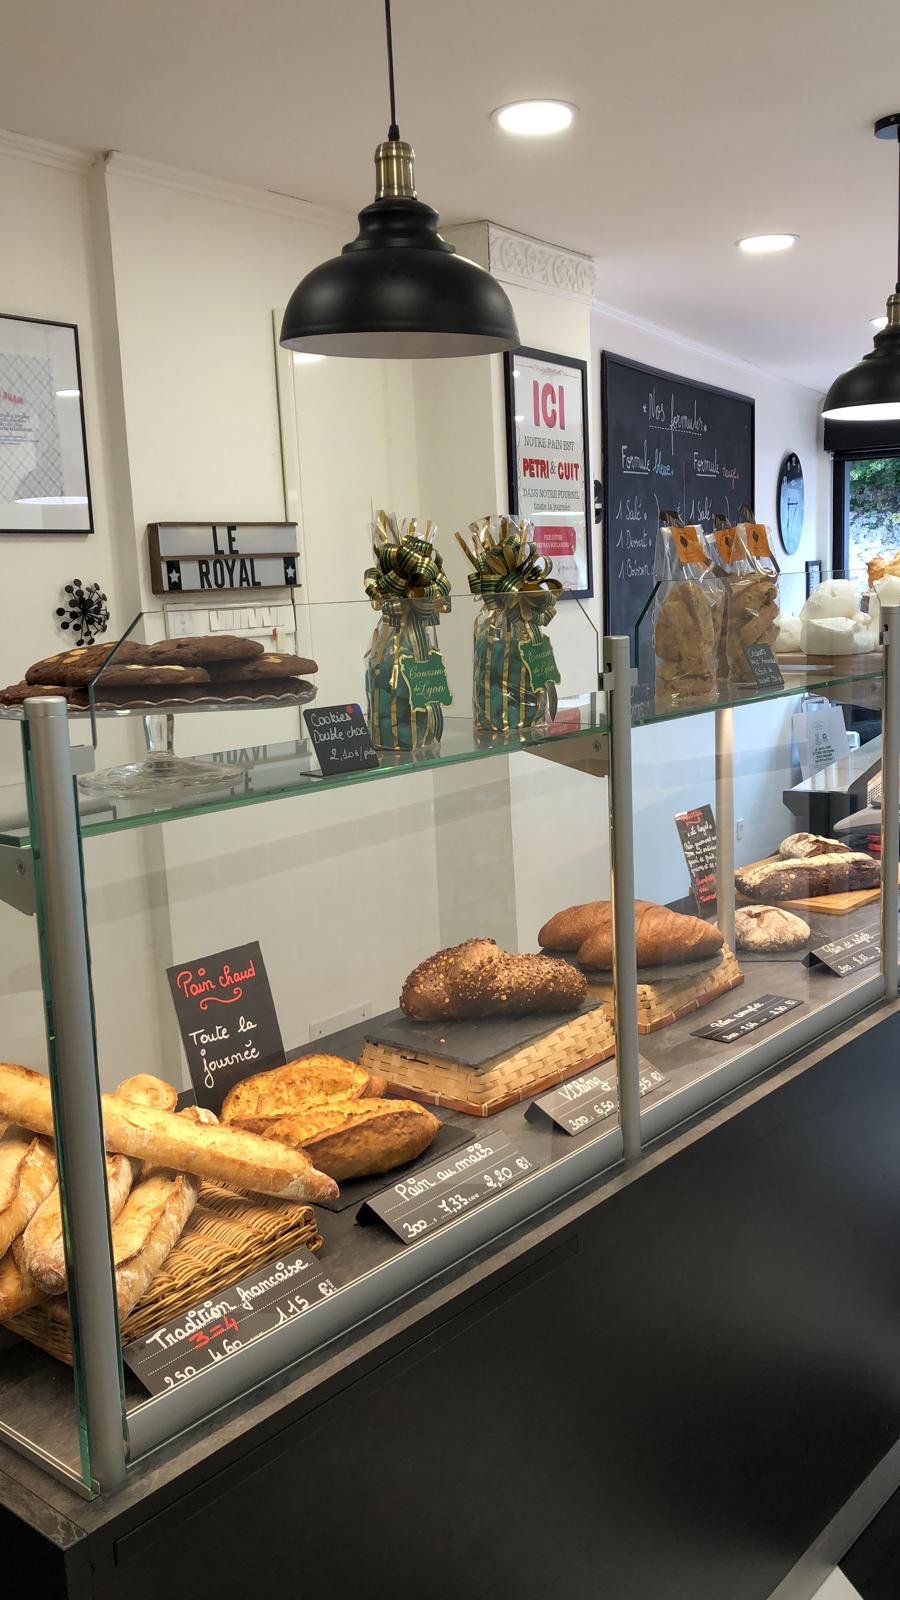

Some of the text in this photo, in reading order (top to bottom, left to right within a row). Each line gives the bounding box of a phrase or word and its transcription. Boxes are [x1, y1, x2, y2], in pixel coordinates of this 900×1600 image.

[532, 379, 566, 431] ICI
[649, 387, 666, 422] Nos
[524, 435, 575, 452] NOTRE PAIN EST
[621, 439, 651, 472] Formule
[550, 461, 557, 475] &
[557, 462, 580, 481] CUIT
[693, 447, 720, 474] Formule
[523, 488, 580, 500] DANS NOTRE FOURNIL
[533, 502, 547, 511] toute
[547, 502, 553, 511] la
[212, 525, 239, 555] LE
[198, 558, 262, 589] ROYAL
[419, 684, 446, 699] Lyon
[310, 711, 352, 727] Cookies
[313, 725, 368, 744] Double choc
[176, 959, 256, 998] Pain chaud
[189, 1016, 257, 1046] Toute la
[200, 1040, 260, 1089] journée
[568, 1115, 589, 1131] 300
[593, 1100, 615, 1117] 6,50
[394, 1178, 436, 1202] Pain
[436, 1168, 457, 1181] au
[403, 1220, 428, 1238] 300
[484, 1167, 513, 1188] 2,20
[145, 1300, 238, 1350] Tradition
